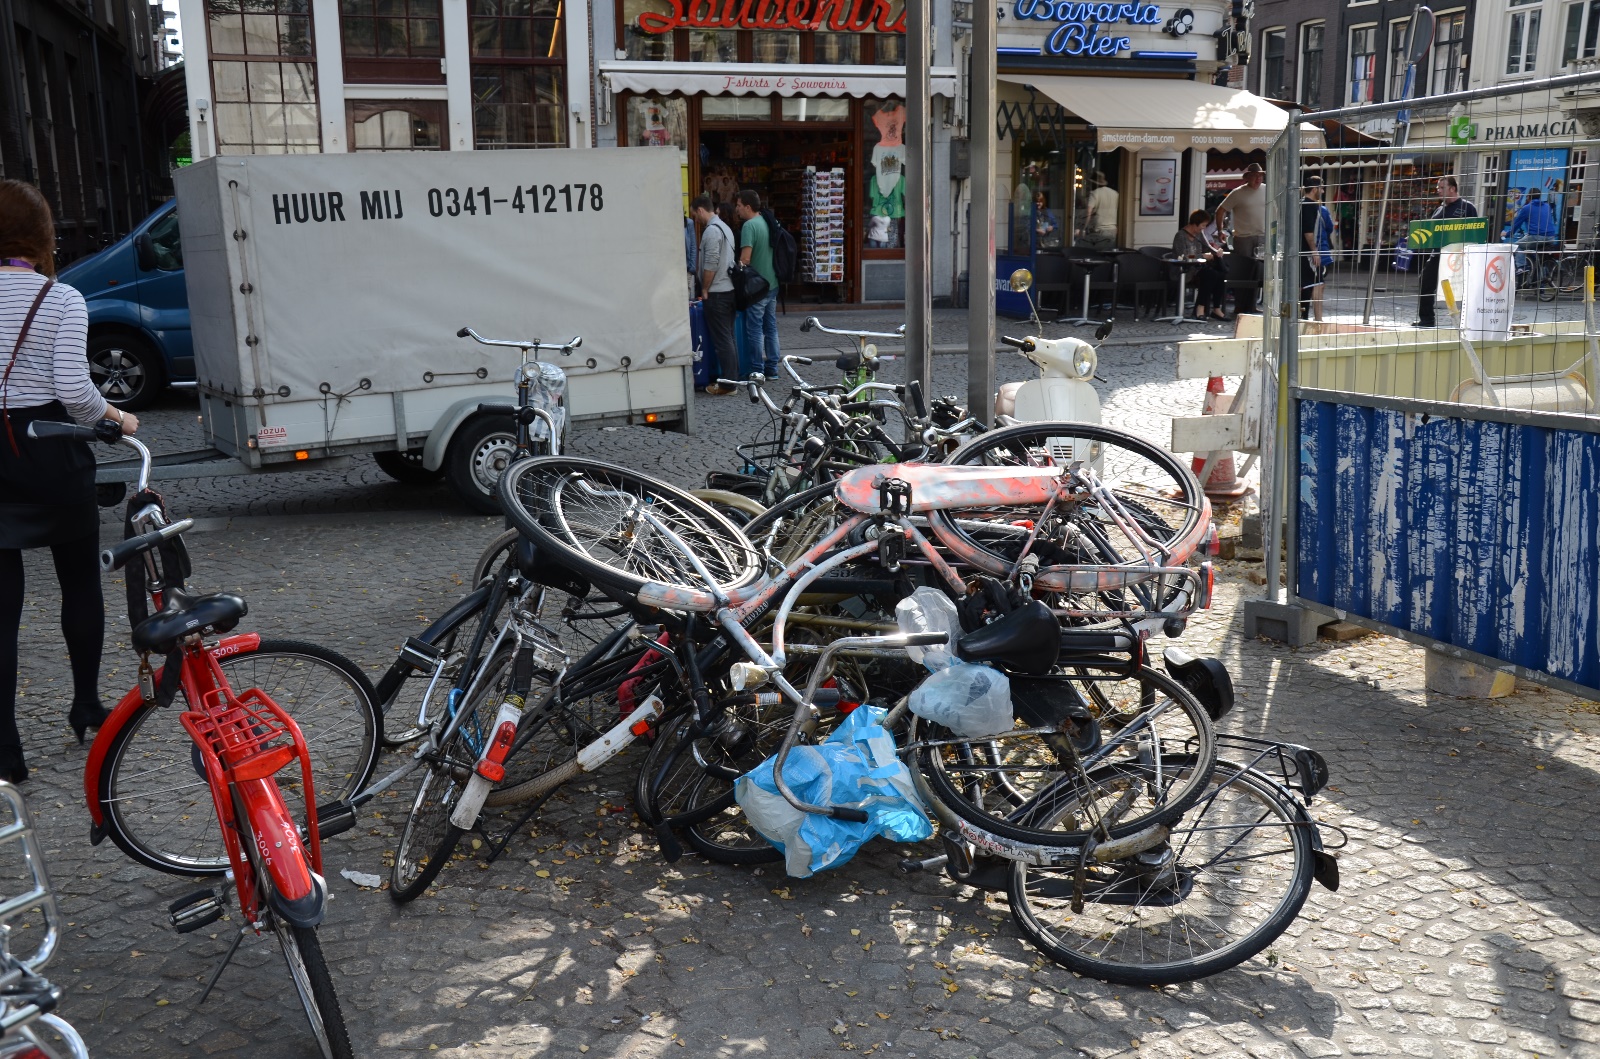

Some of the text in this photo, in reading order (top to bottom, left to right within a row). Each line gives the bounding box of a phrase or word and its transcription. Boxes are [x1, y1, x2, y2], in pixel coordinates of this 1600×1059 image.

[1014, 0, 1163, 24] Bavaria
[1044, 22, 1131, 57] Bier
[723, 76, 847, 90] T-shirts & Souvenirs
[1102, 133, 1175, 143] amsterdam-dam.com
[1191, 136, 1208, 144] FOOD
[1213, 136, 1233, 144] DRINKS
[1485, 121, 1578, 141] PHARMACIA
[272, 183, 604, 225] HUUR MIJ 0341-412178
[258, 427, 286, 436] JOZUA
